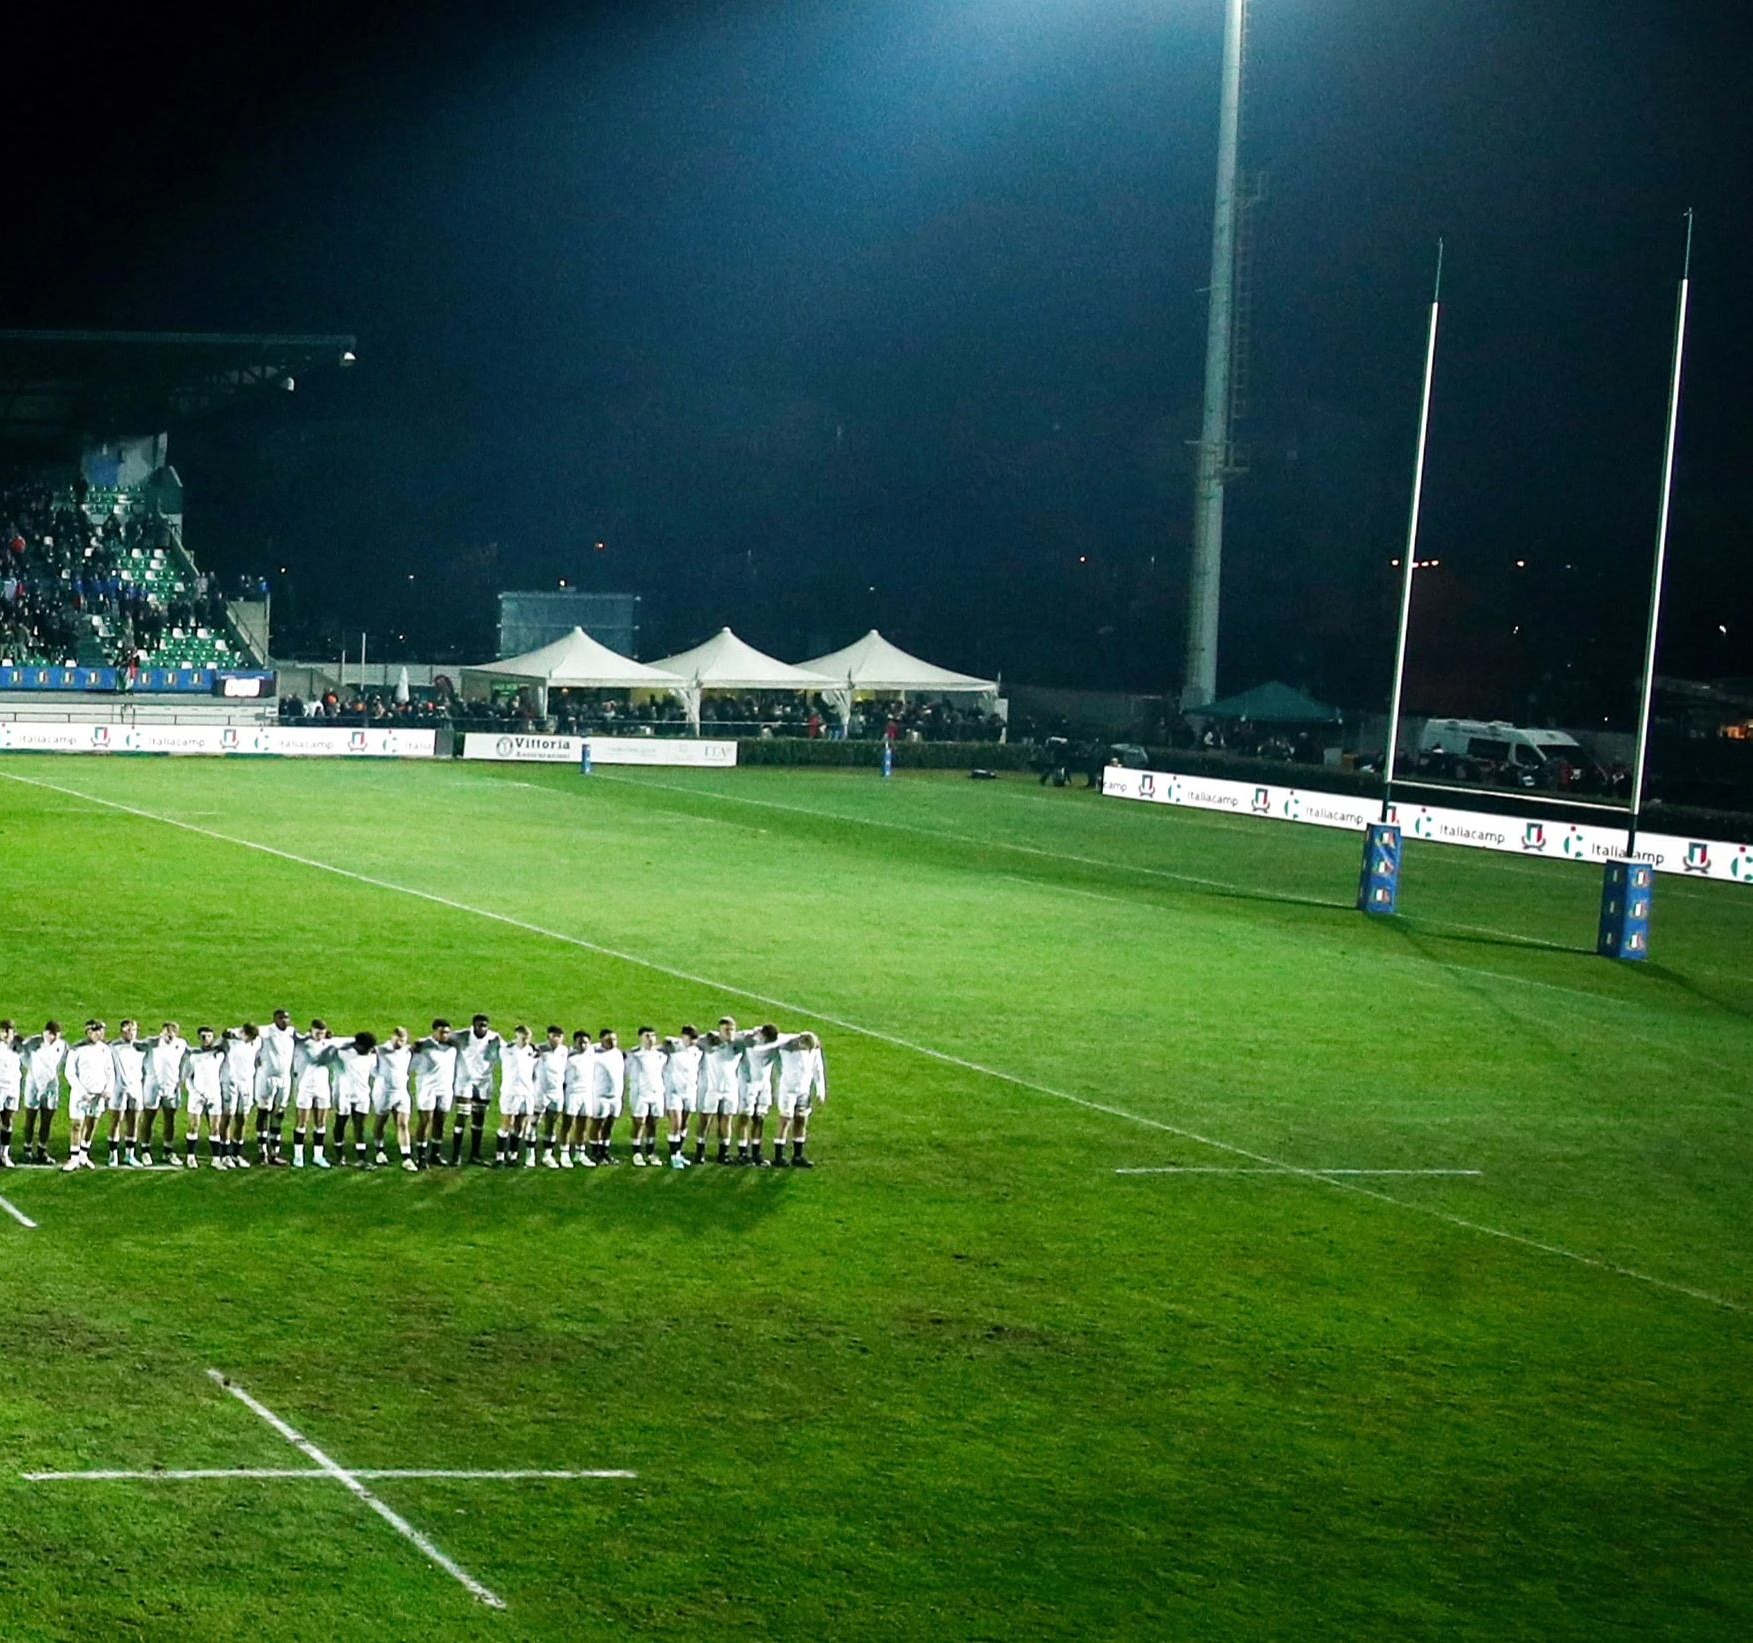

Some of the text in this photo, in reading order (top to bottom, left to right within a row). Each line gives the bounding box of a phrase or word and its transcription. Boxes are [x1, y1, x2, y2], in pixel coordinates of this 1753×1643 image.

[19, 735, 77, 745] Italiacamp
[148, 738, 206, 748] Italiacamp
[277, 740, 334, 750] Italiacamp
[515, 738, 570, 749] Vittoria
[1188, 791, 1238, 808] Italiacamp
[1306, 806, 1363, 826] Italiacamp
[1440, 824, 1505, 845] Italiacamp
[1591, 843, 1664, 866] Italiaamp
